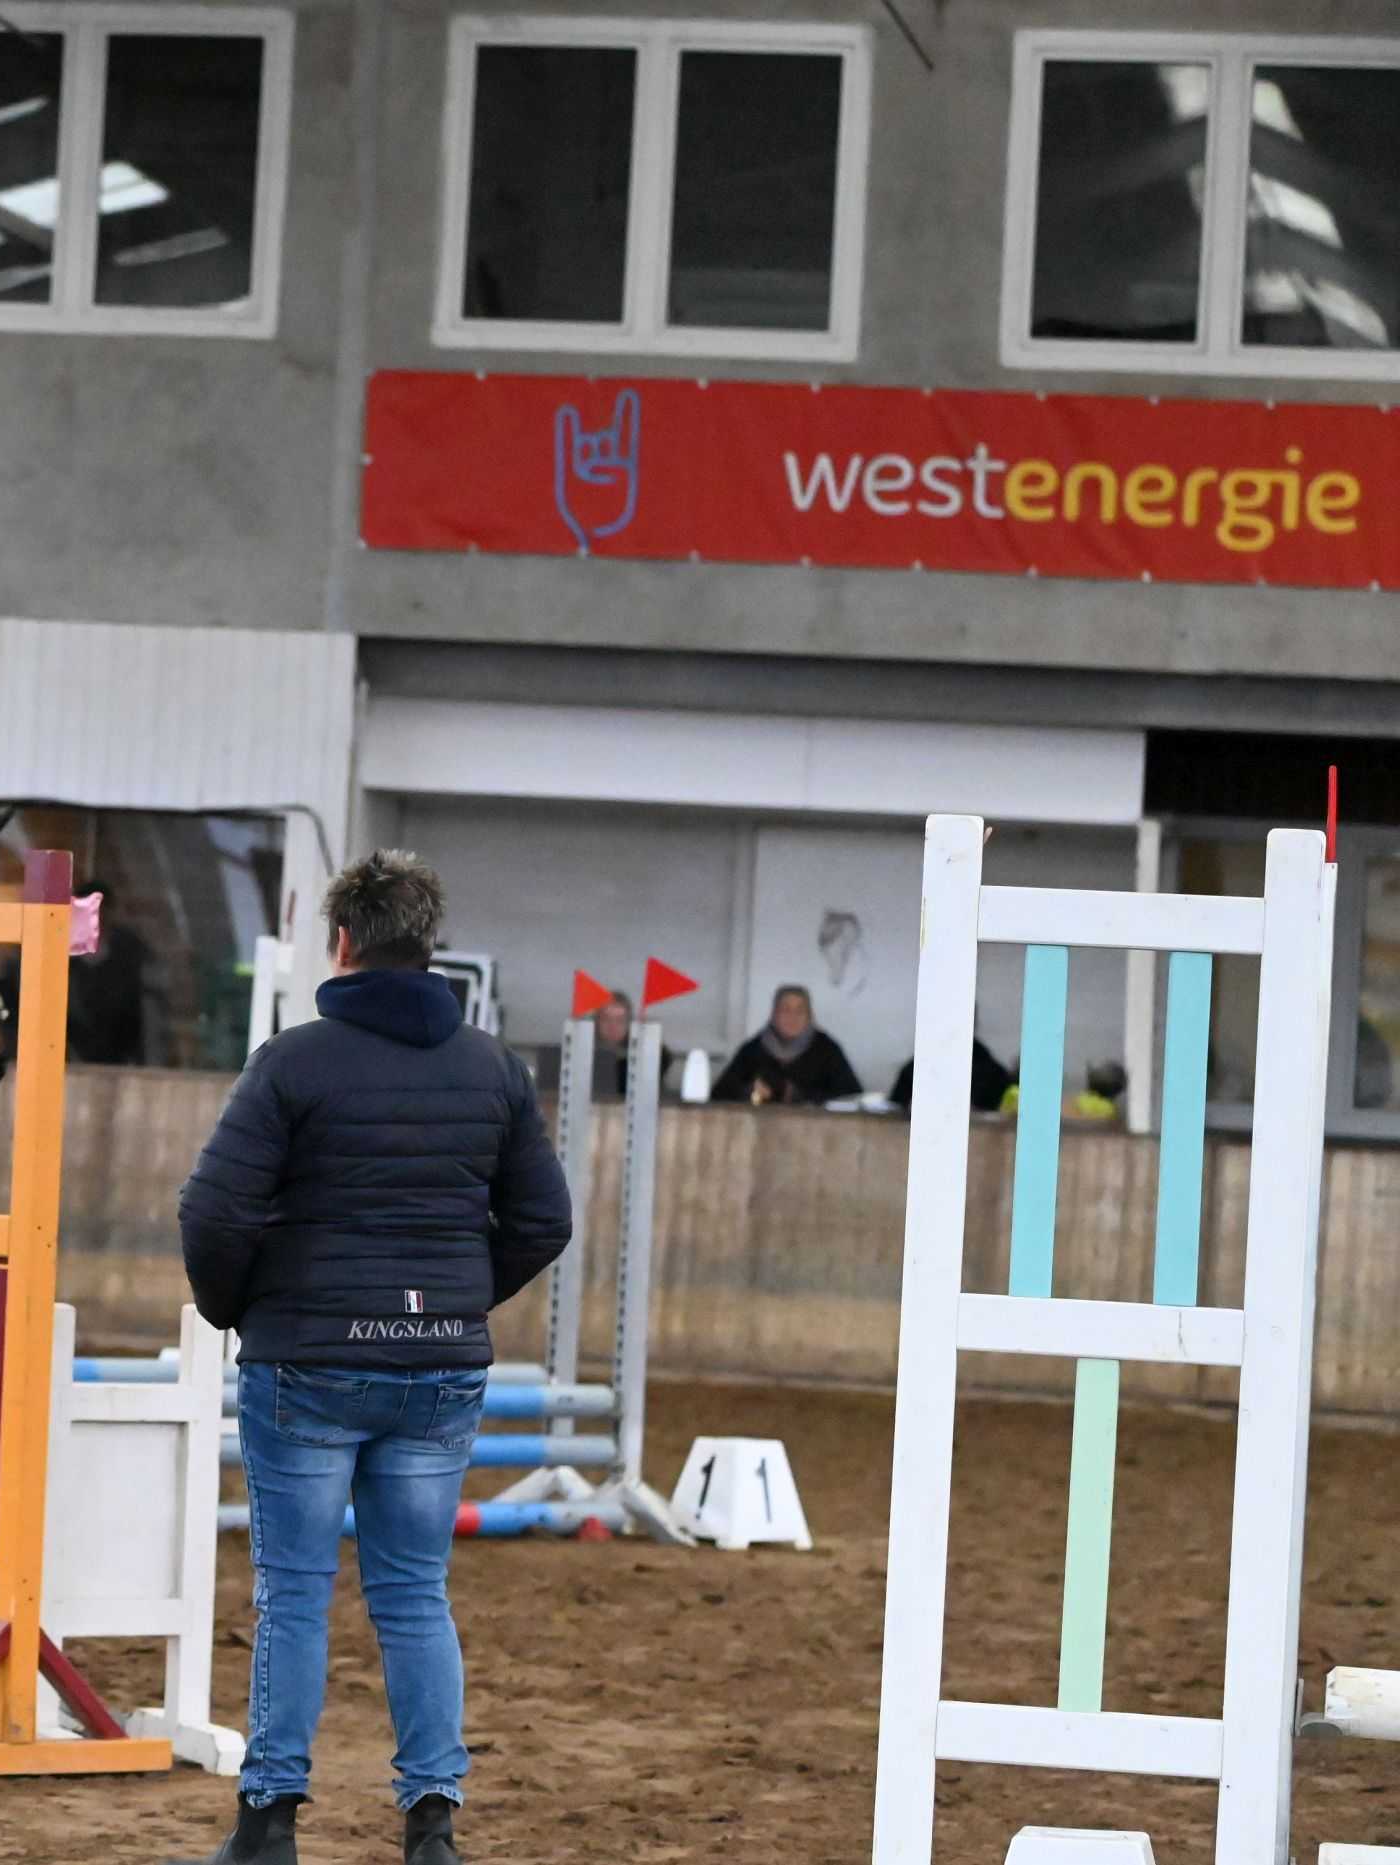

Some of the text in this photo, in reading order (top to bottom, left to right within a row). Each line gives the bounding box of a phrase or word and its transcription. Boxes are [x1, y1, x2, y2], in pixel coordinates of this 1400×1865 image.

[784, 443, 1360, 552] westenergie
[347, 1319, 464, 1340] KINGSLAND
[696, 1454, 715, 1520] 1
[756, 1458, 771, 1523] 1
